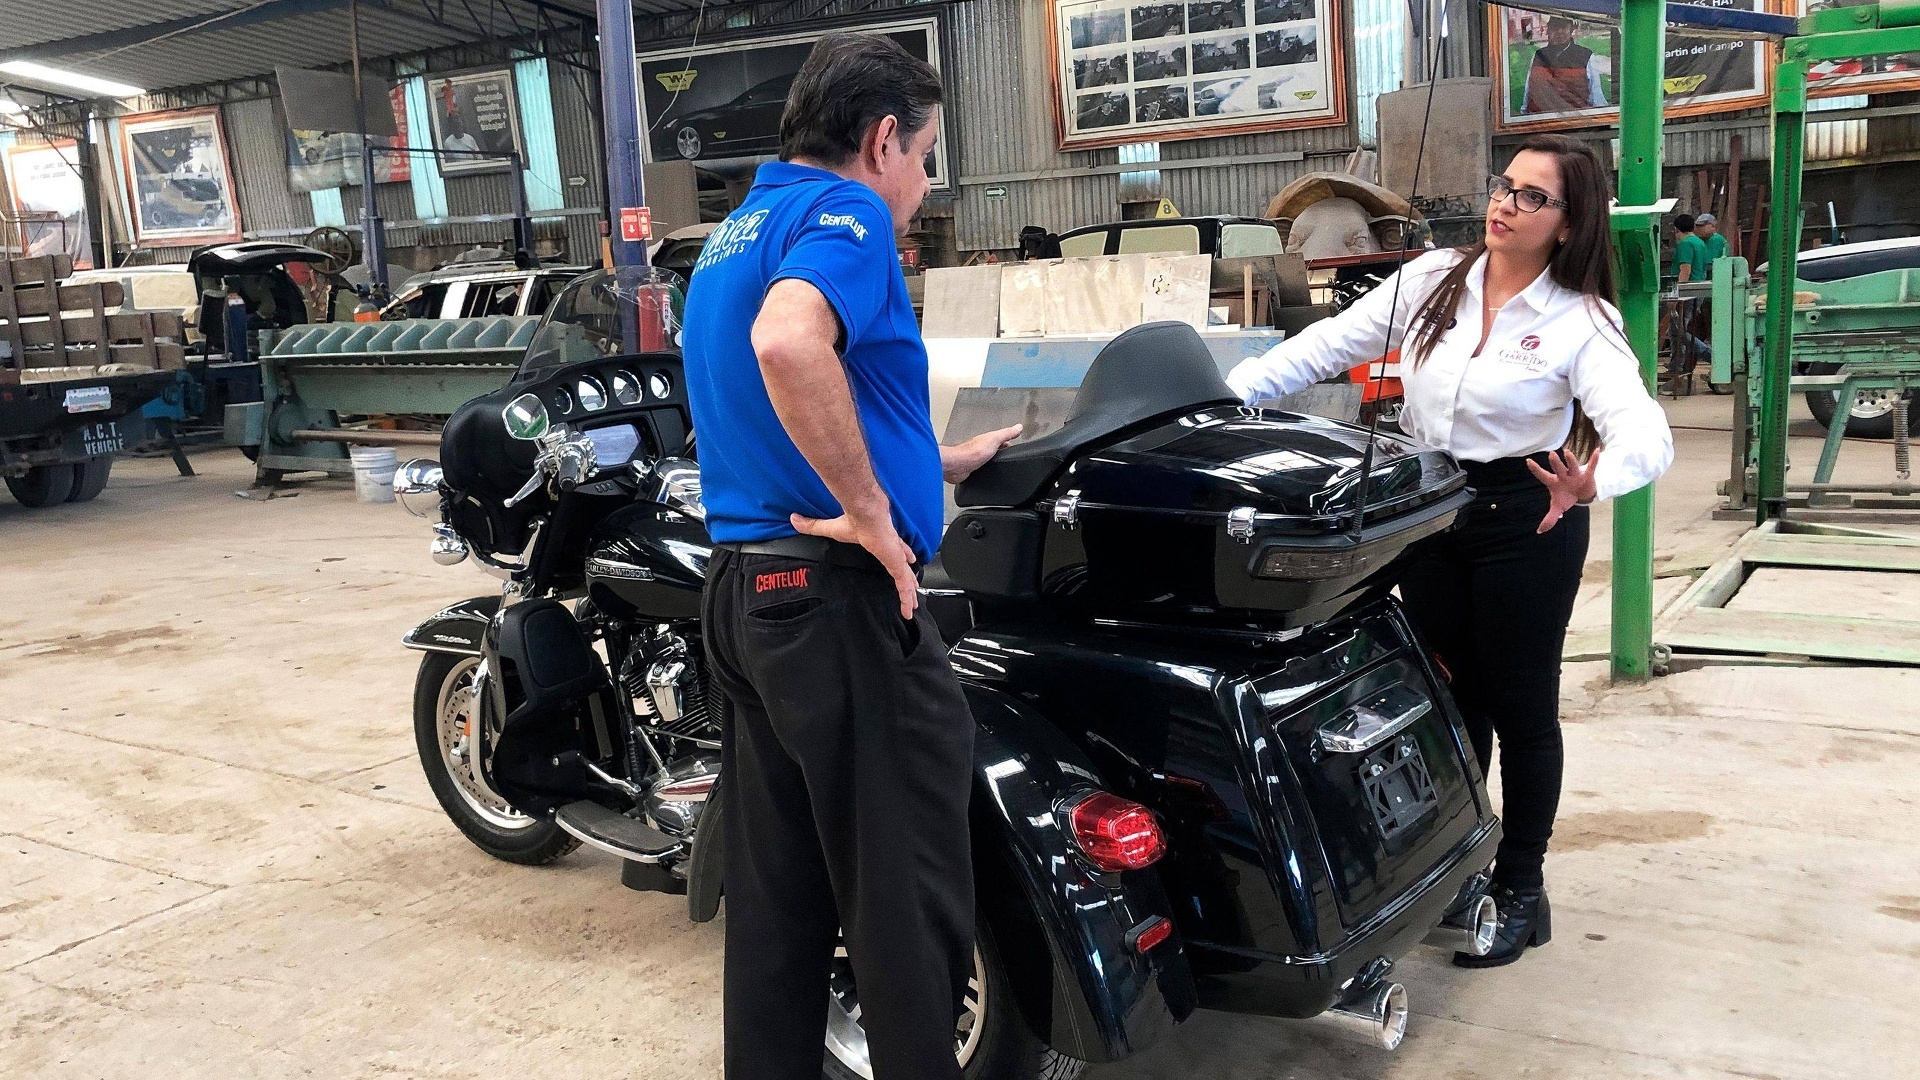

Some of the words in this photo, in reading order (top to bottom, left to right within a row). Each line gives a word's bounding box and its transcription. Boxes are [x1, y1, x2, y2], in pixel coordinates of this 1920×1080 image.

[1665, 48, 1688, 58] artin
[1691, 44, 1707, 55] del
[1163, 204, 1171, 214] 8
[819, 213, 867, 241] CENTELUX
[85, 438, 124, 455] VEHICLE
[756, 568, 808, 593] CENTELUX
